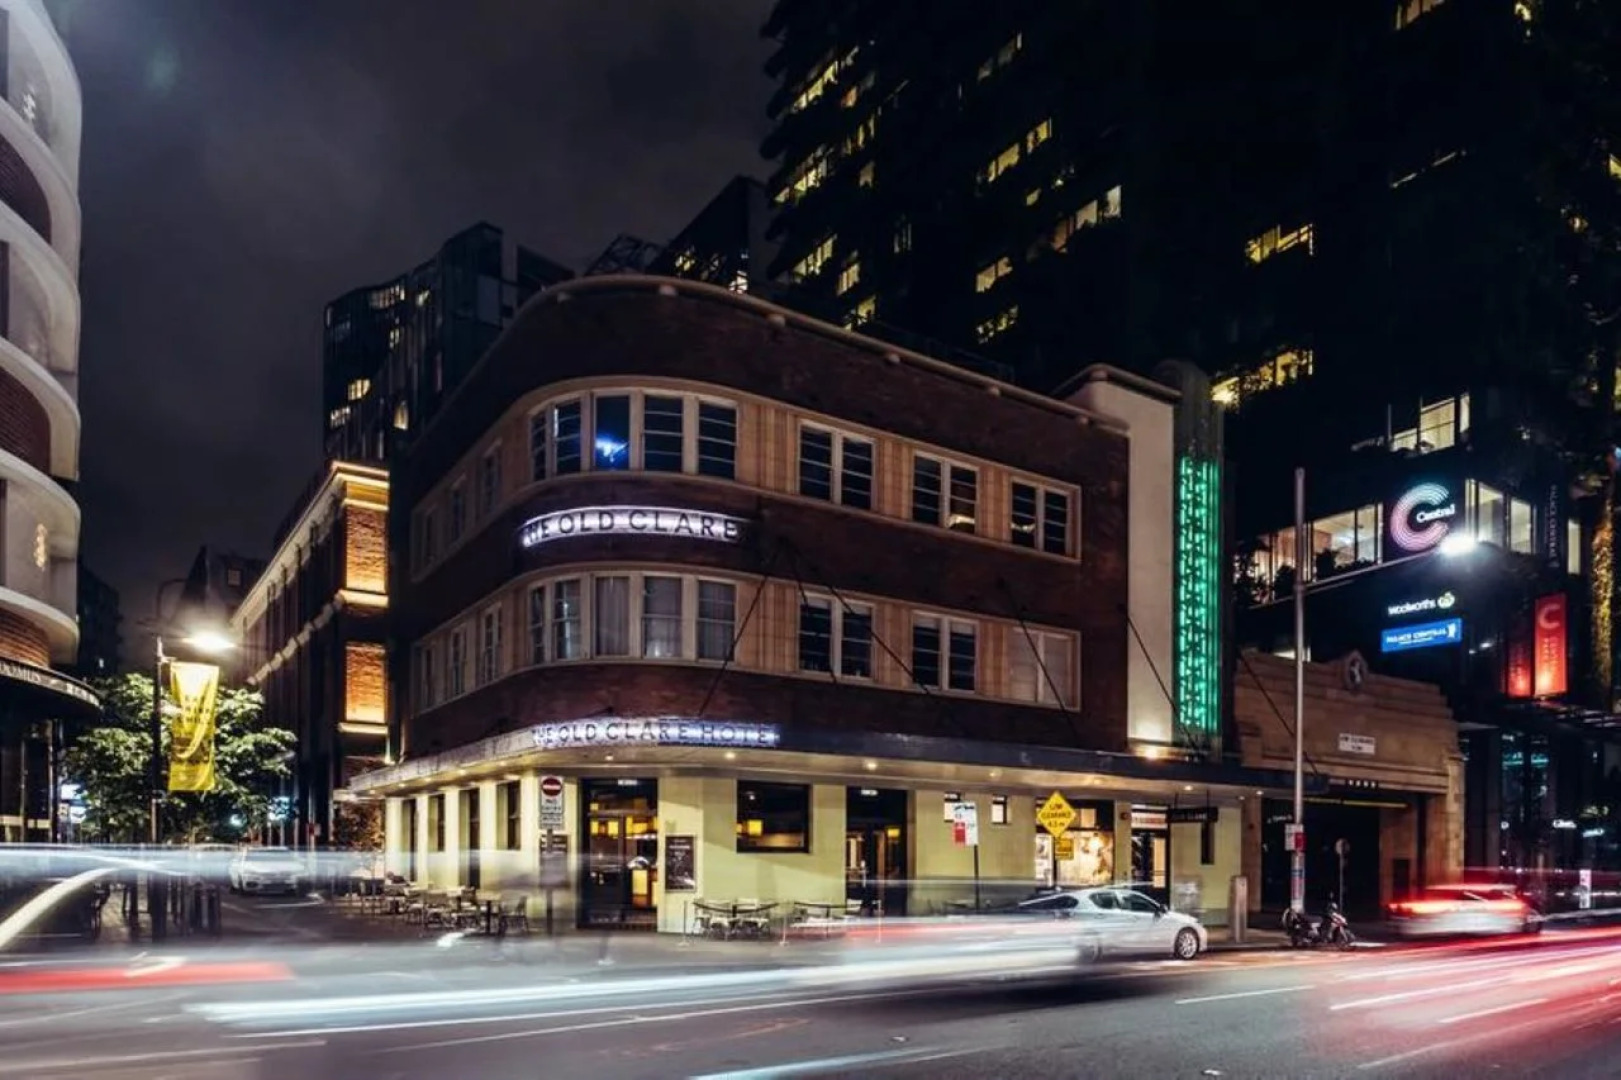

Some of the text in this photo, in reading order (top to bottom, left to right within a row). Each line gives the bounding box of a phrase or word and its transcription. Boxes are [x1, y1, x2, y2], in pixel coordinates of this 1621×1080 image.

[559, 509, 614, 534] OLD
[628, 509, 739, 540] CLARE
[1416, 503, 1455, 523] Central
[558, 722, 597, 743] OLD
[606, 720, 689, 741] CLARE
